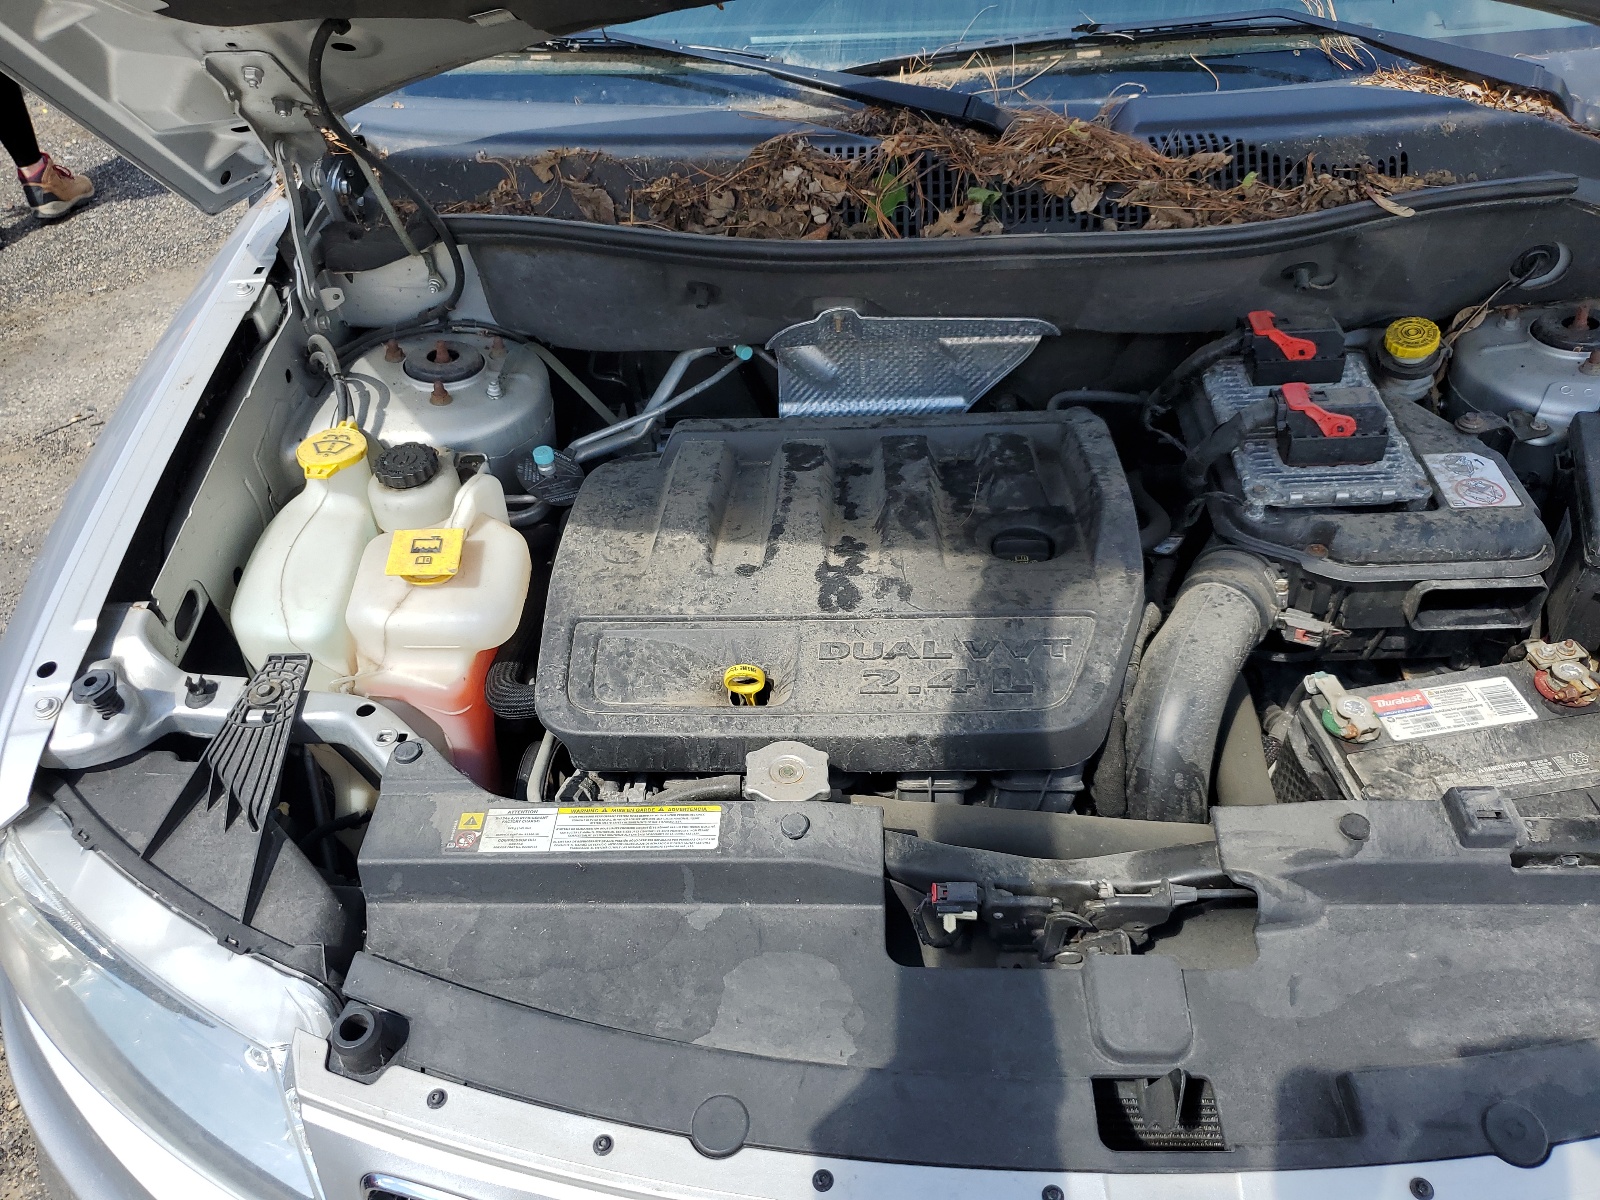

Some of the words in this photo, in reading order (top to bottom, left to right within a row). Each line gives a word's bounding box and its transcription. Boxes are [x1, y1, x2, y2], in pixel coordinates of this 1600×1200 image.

[818, 641, 952, 660] DUAL
[962, 638, 1072, 661] VVT
[859, 668, 1034, 694] 2.4L
[1374, 693, 1422, 708] Duralast
